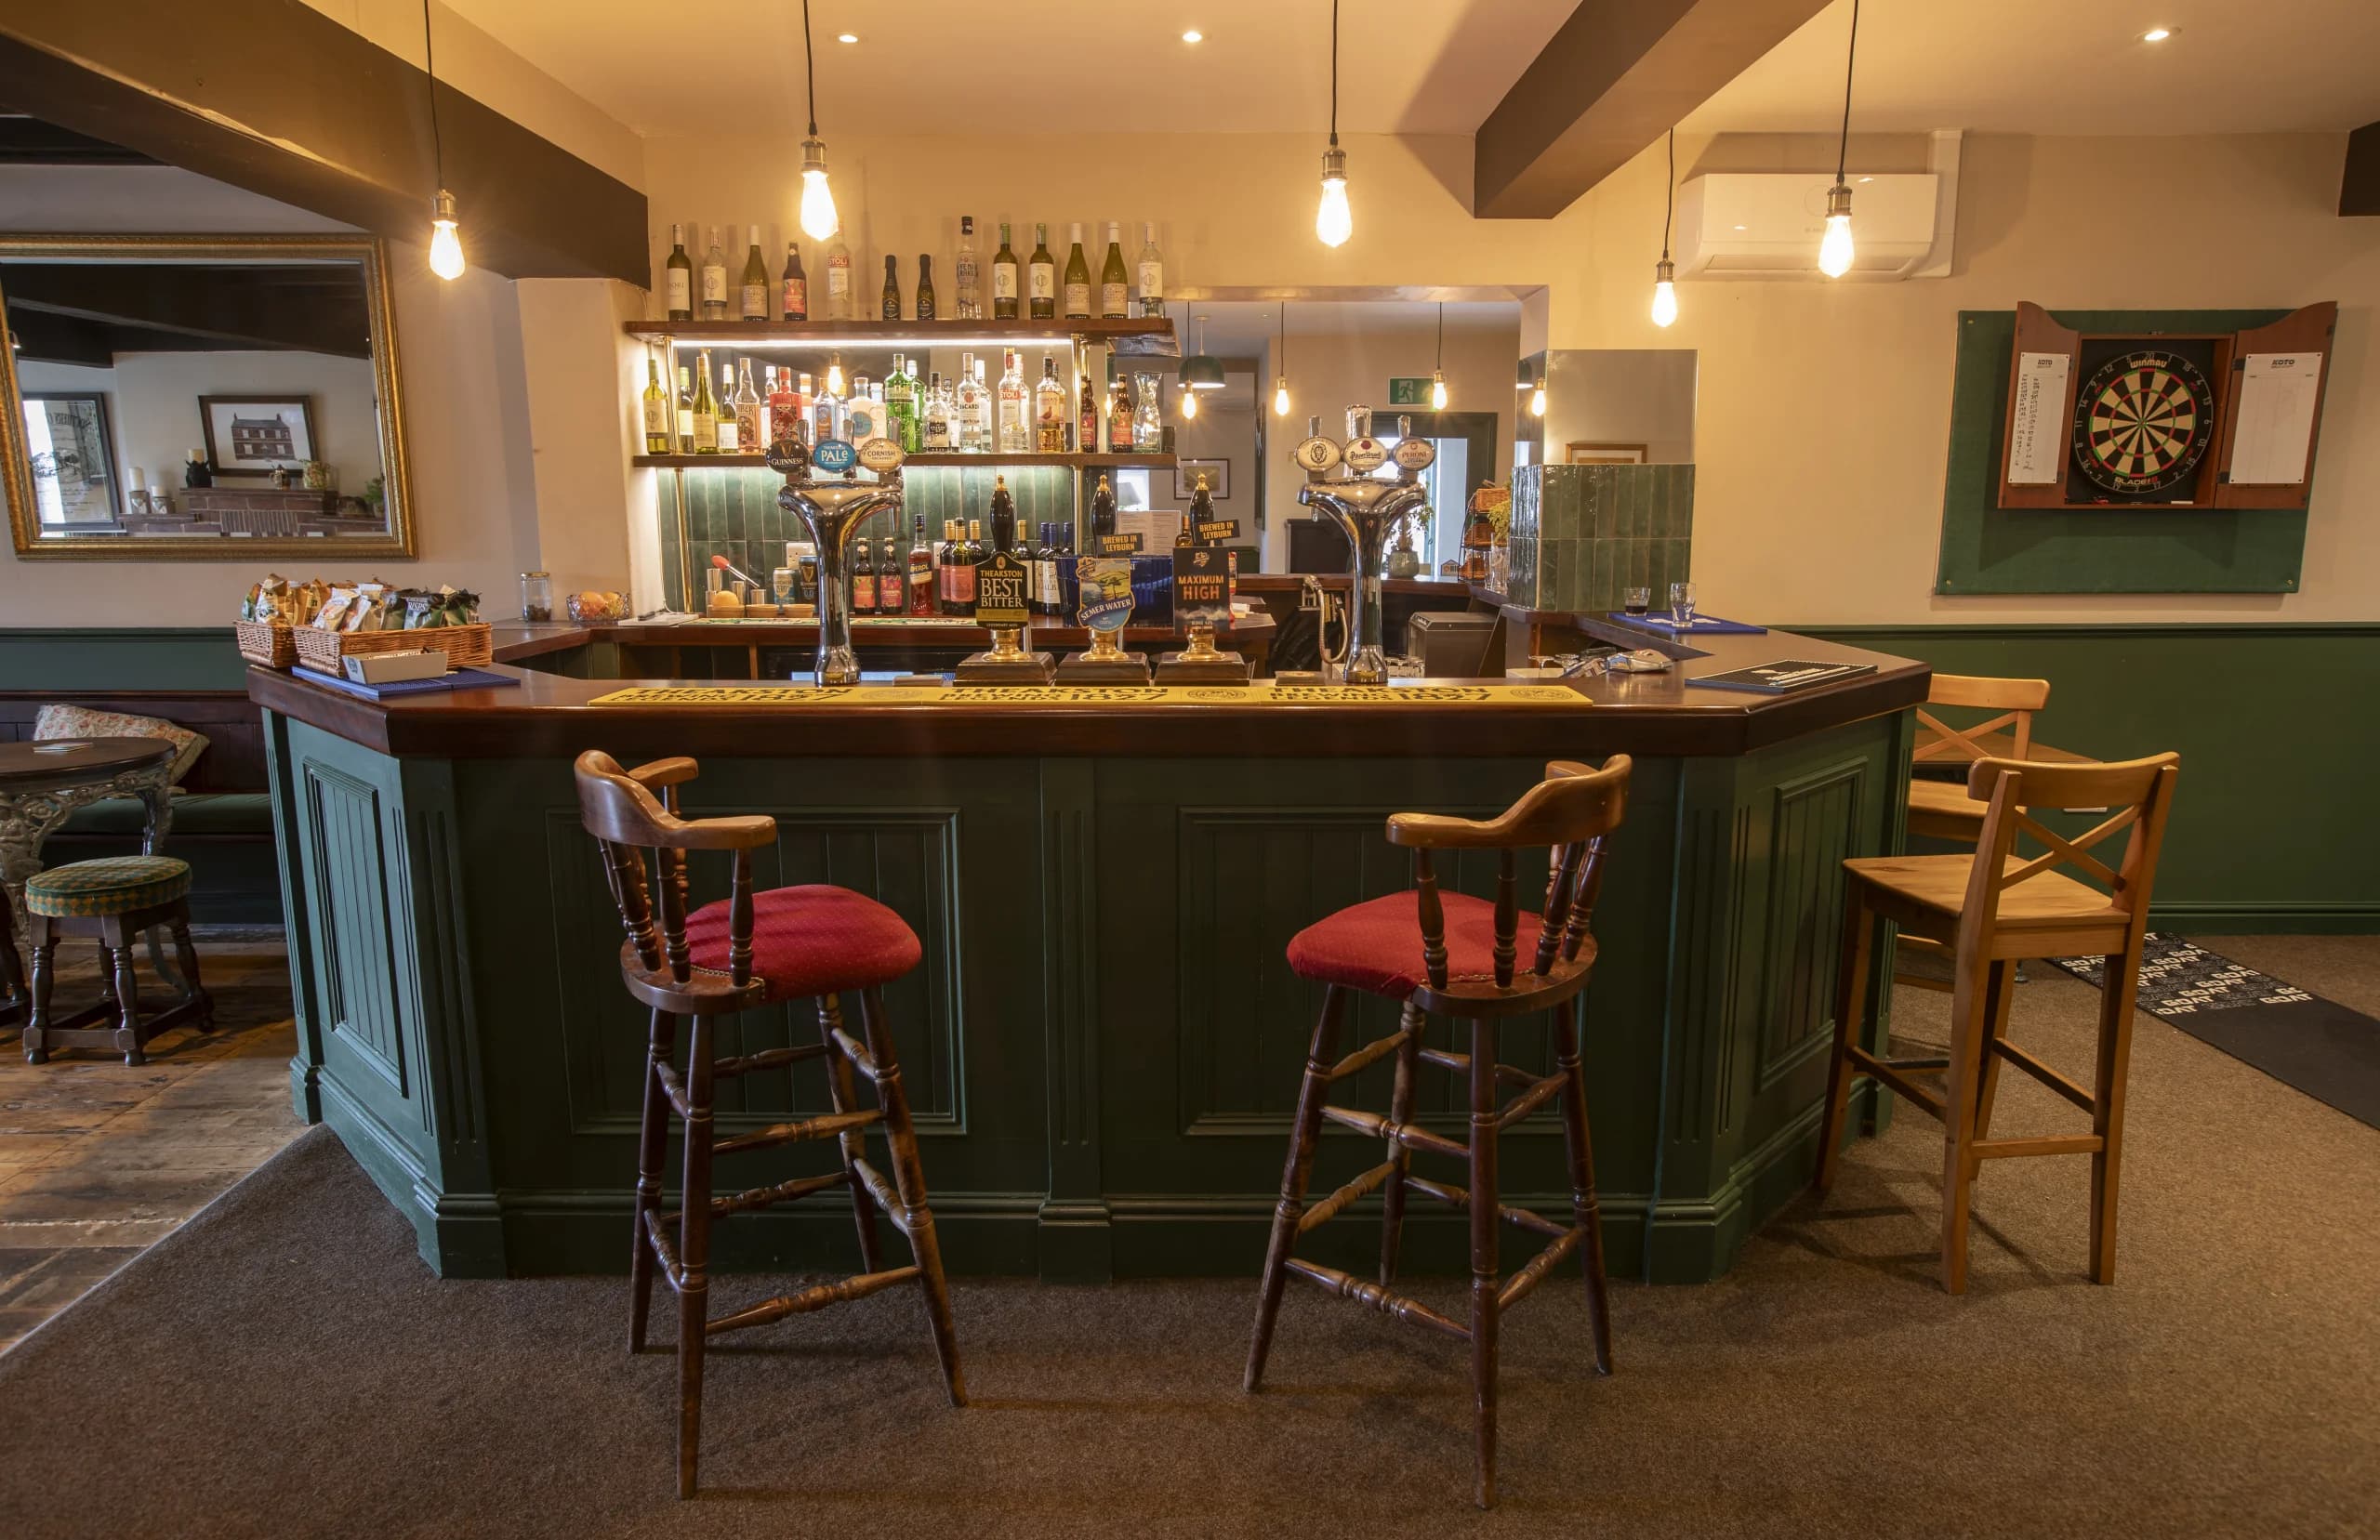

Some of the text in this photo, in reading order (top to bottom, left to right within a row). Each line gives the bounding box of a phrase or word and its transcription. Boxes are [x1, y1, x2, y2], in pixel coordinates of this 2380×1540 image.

[999, 390, 1018, 399] STOLI
[771, 457, 804, 466] GUINNESS
[1199, 520, 1235, 533] BREWED IN
[1102, 534, 1138, 545] BREWED IN
[1203, 529, 1232, 540] LEYBURN
[1105, 543, 1135, 552] LEYBURN
[1178, 575, 1224, 585] MAXIMUM
[980, 578, 1023, 597] BEST
[1183, 586, 1220, 600] HIGH
[981, 597, 1025, 608] BITTER
[1080, 604, 1105, 621] SEMER
[1105, 599, 1131, 611] WATER
[2150, 956, 2201, 966] GOAT
[2137, 971, 2168, 981] OAT
[2211, 969, 2261, 980] GOAT
[2195, 978, 2247, 988] GOAT
[2178, 986, 2231, 997] GOAT
[2161, 995, 2215, 1007] GOAT
[2259, 994, 2314, 1004] GOAT
[2151, 1005, 2198, 1015] OAT
